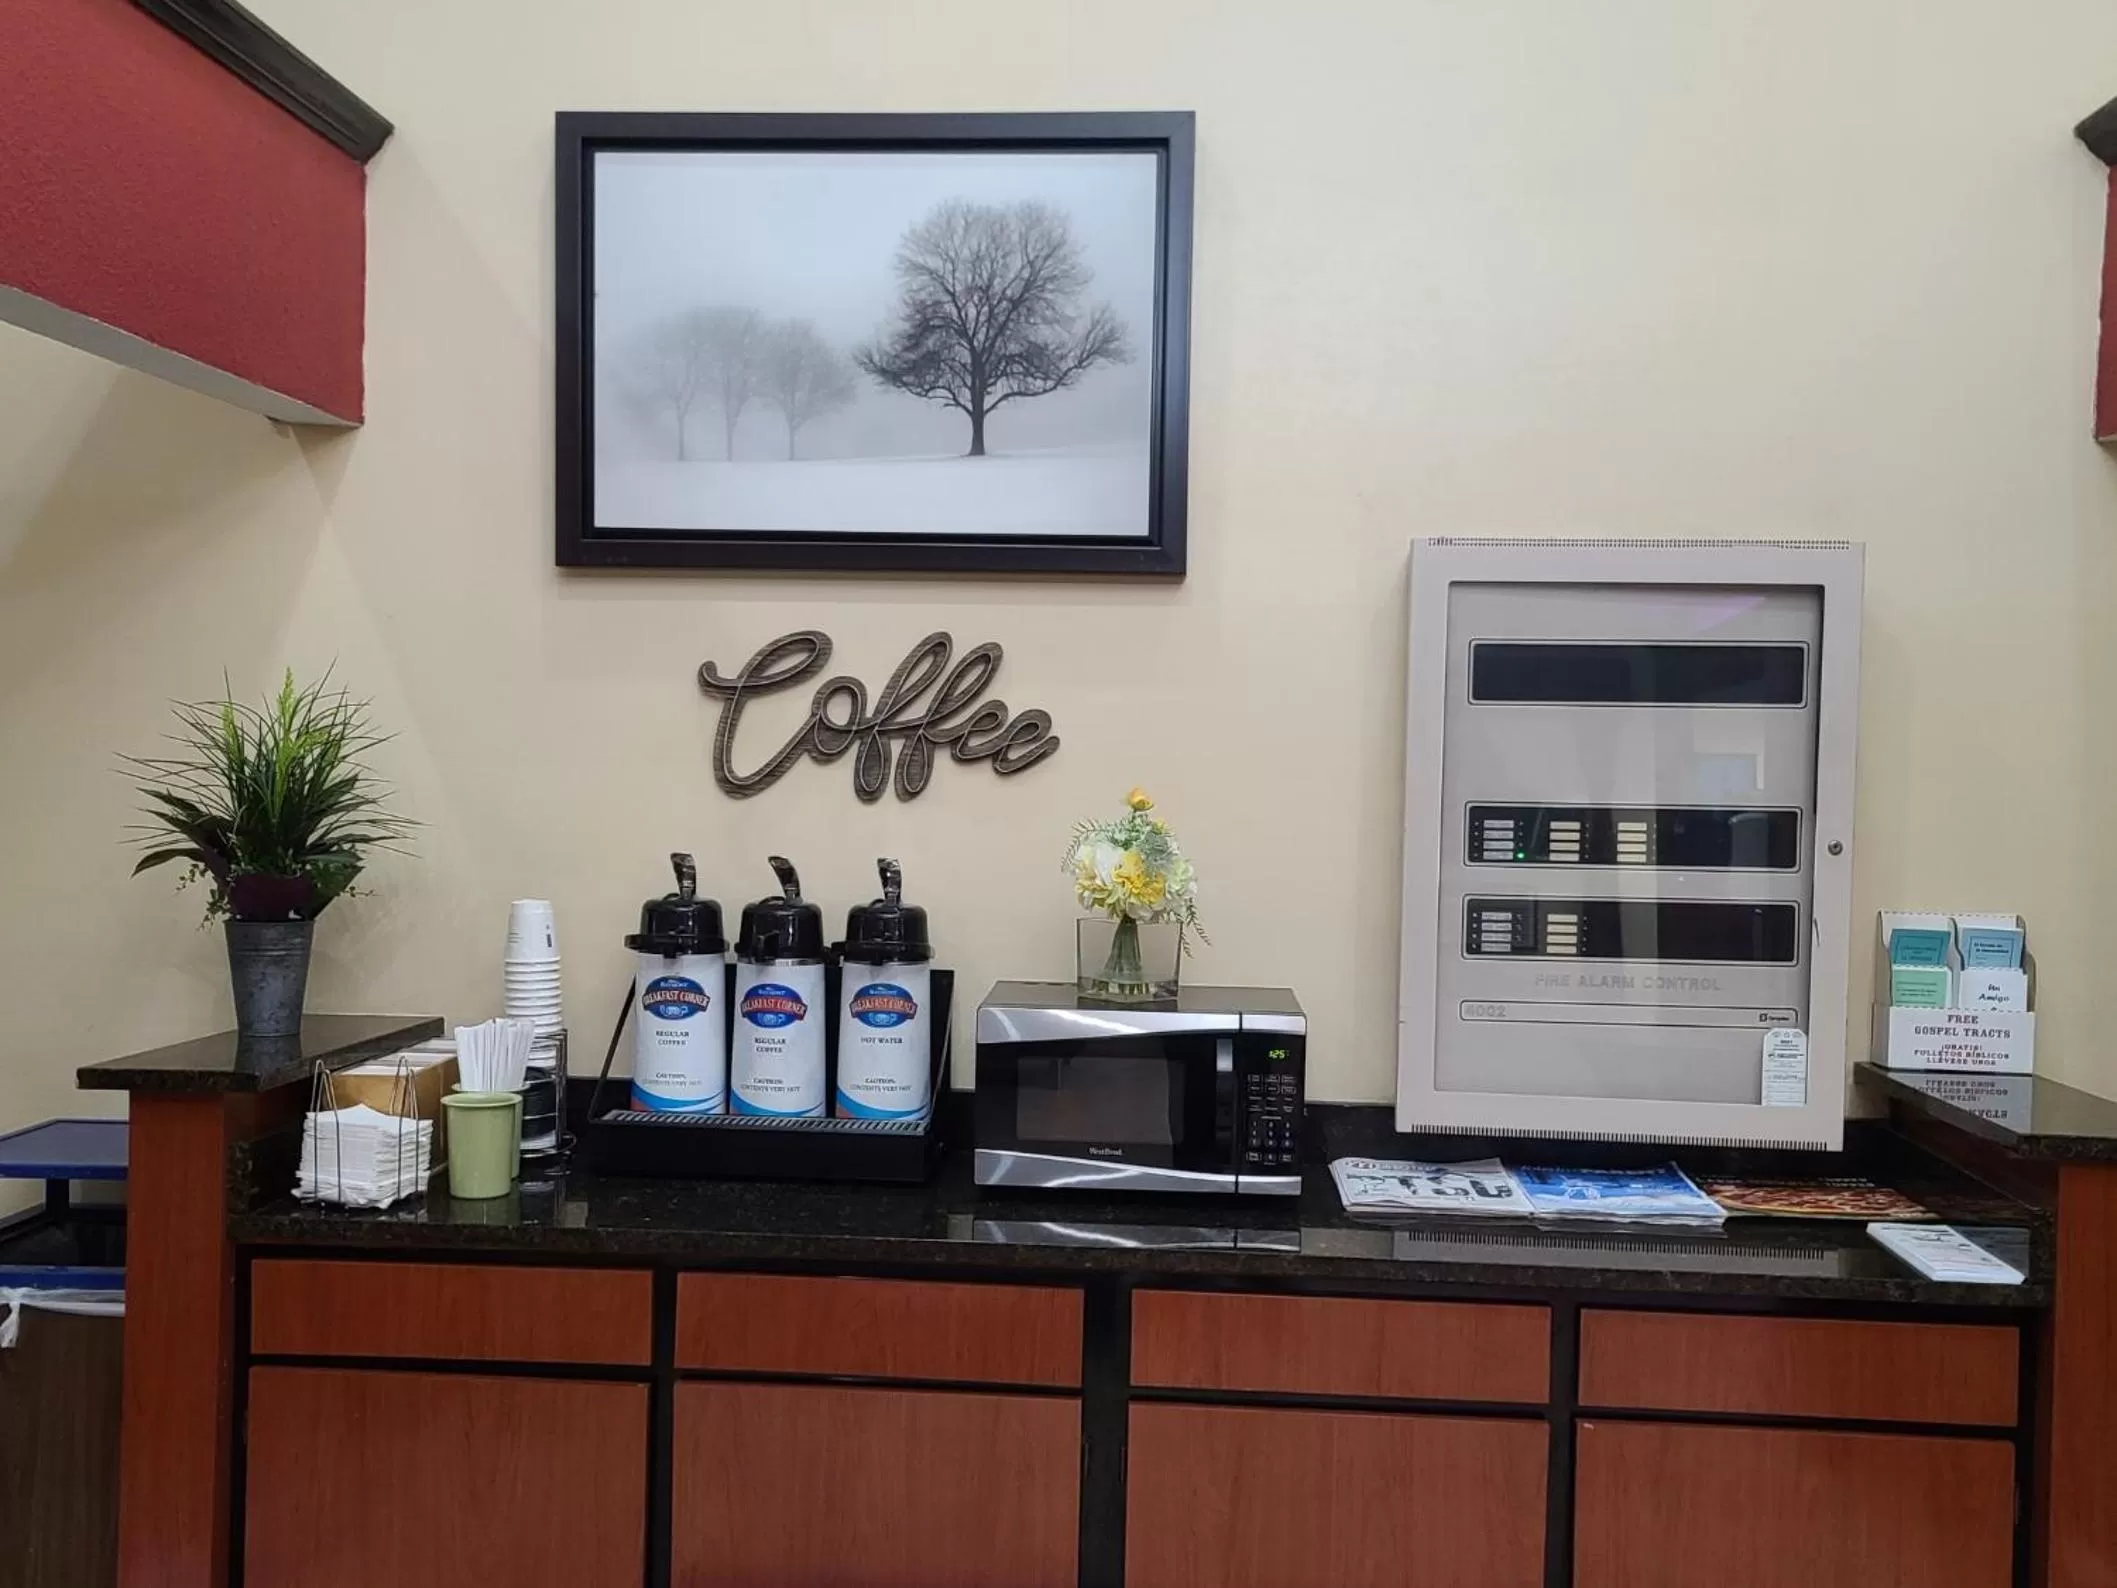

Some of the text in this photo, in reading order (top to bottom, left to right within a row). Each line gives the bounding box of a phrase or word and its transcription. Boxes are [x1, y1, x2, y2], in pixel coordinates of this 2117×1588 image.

[698, 630, 1060, 805] Coffee
[1535, 974, 1723, 991] FIRE ALARM CONTROL
[1978, 993, 2010, 1004] Amigo
[1947, 1014, 1979, 1025] FREE
[1914, 1025, 2011, 1039] GOSPEL TRACTS
[754, 1037, 786, 1045] REGULAR
[860, 1037, 903, 1045] HOT WATER
[1914, 1049, 1963, 1058] FOLLETOS
